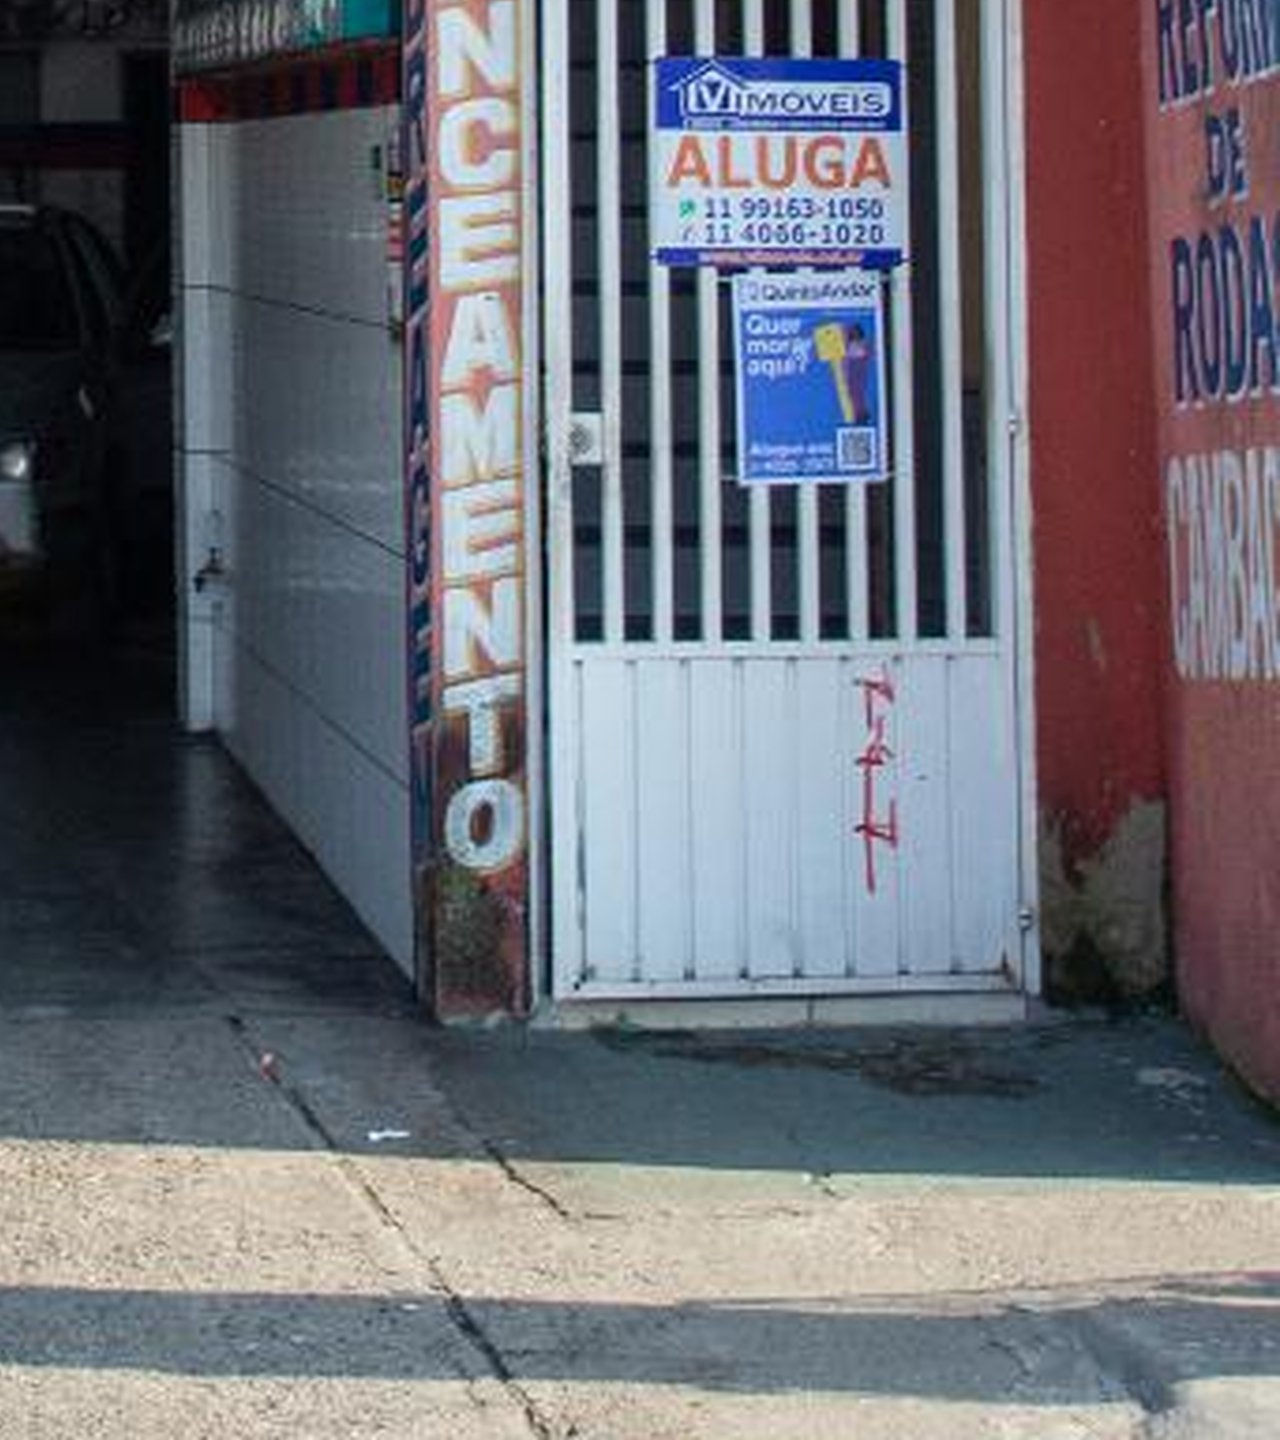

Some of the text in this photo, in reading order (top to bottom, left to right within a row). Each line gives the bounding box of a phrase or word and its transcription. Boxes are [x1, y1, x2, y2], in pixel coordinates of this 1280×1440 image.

[667, 134, 891, 190] ALUGA
[1205, 104, 1250, 204] DE
[704, 198, 884, 220] 11 99163-1050
[704, 224, 731, 245] 11
[1169, 212, 1280, 411] RODA
[745, 314, 802, 336] Quer
[745, 355, 808, 380] aqui?
